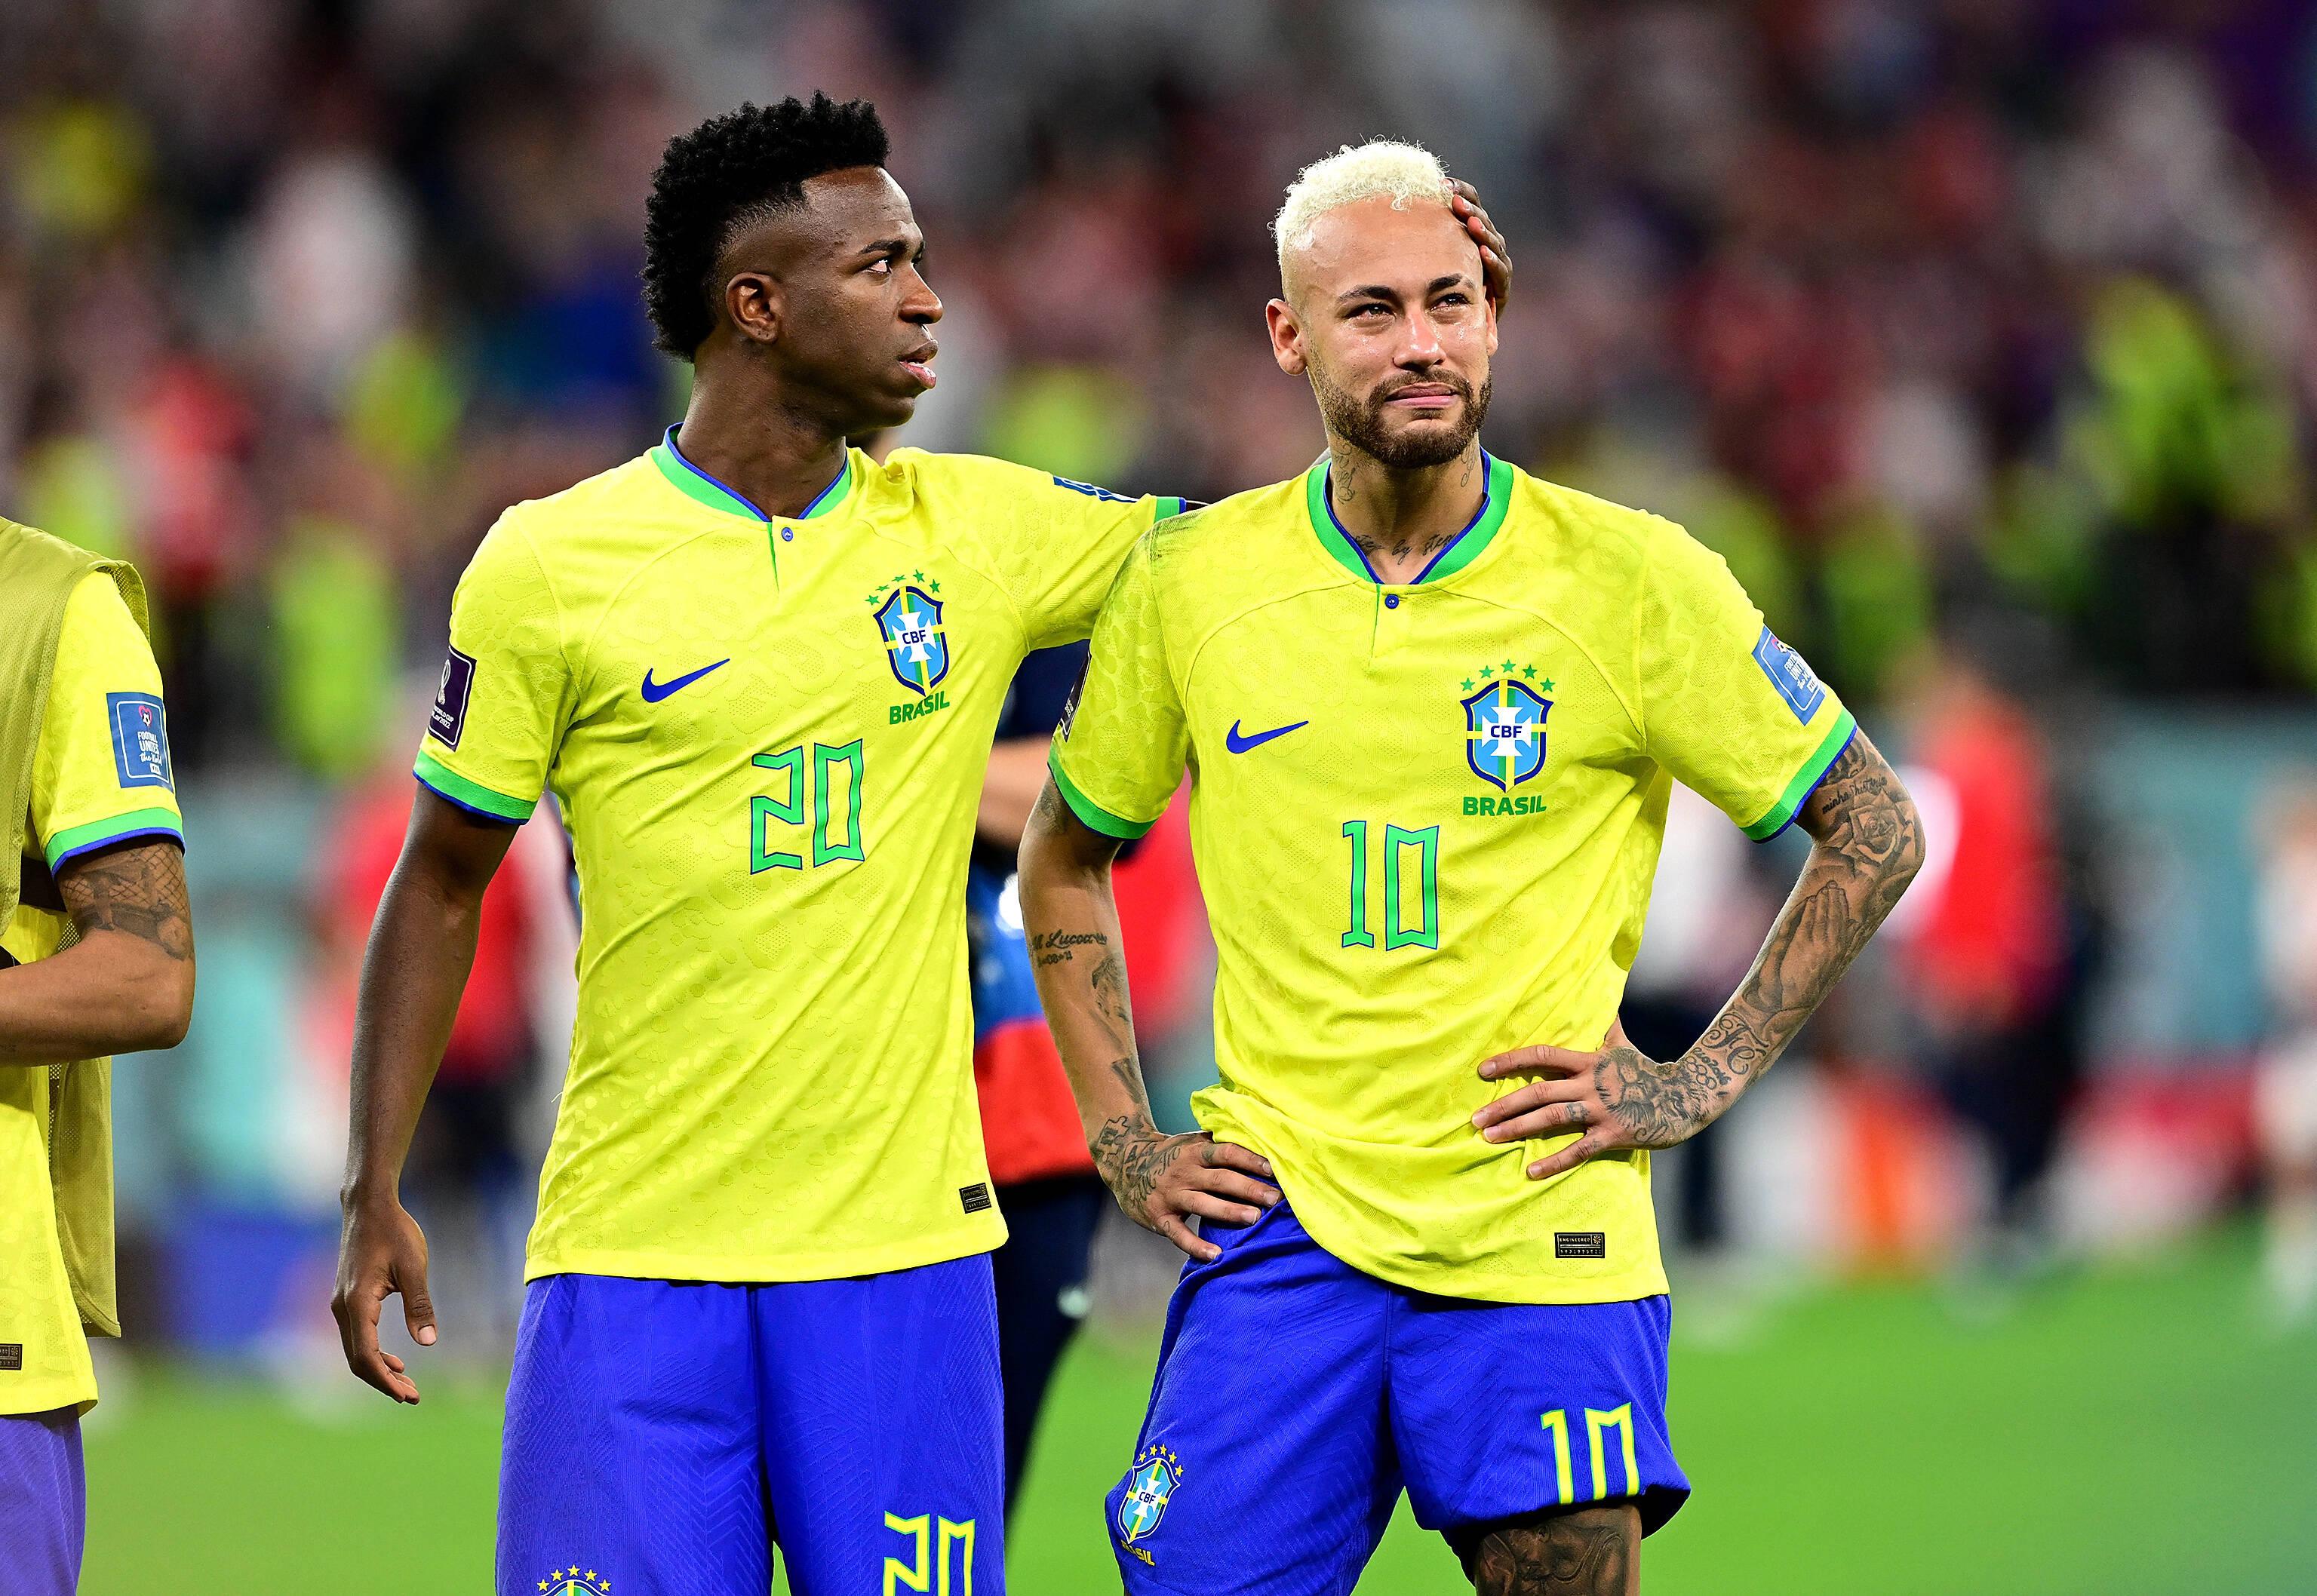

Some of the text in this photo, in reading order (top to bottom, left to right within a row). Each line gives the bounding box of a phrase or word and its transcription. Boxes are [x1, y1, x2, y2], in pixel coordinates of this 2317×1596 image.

[902, 629, 926, 645] CBF
[889, 690, 951, 725] BRASIL
[1490, 725, 1523, 738] CBF
[750, 738, 865, 875] 20
[1462, 794, 1547, 817] BRASIL
[1341, 820, 1440, 951] 10
[1540, 1401, 1640, 1505] 10
[1139, 1491, 1157, 1505] CBF
[882, 1510, 976, 1596] 20
